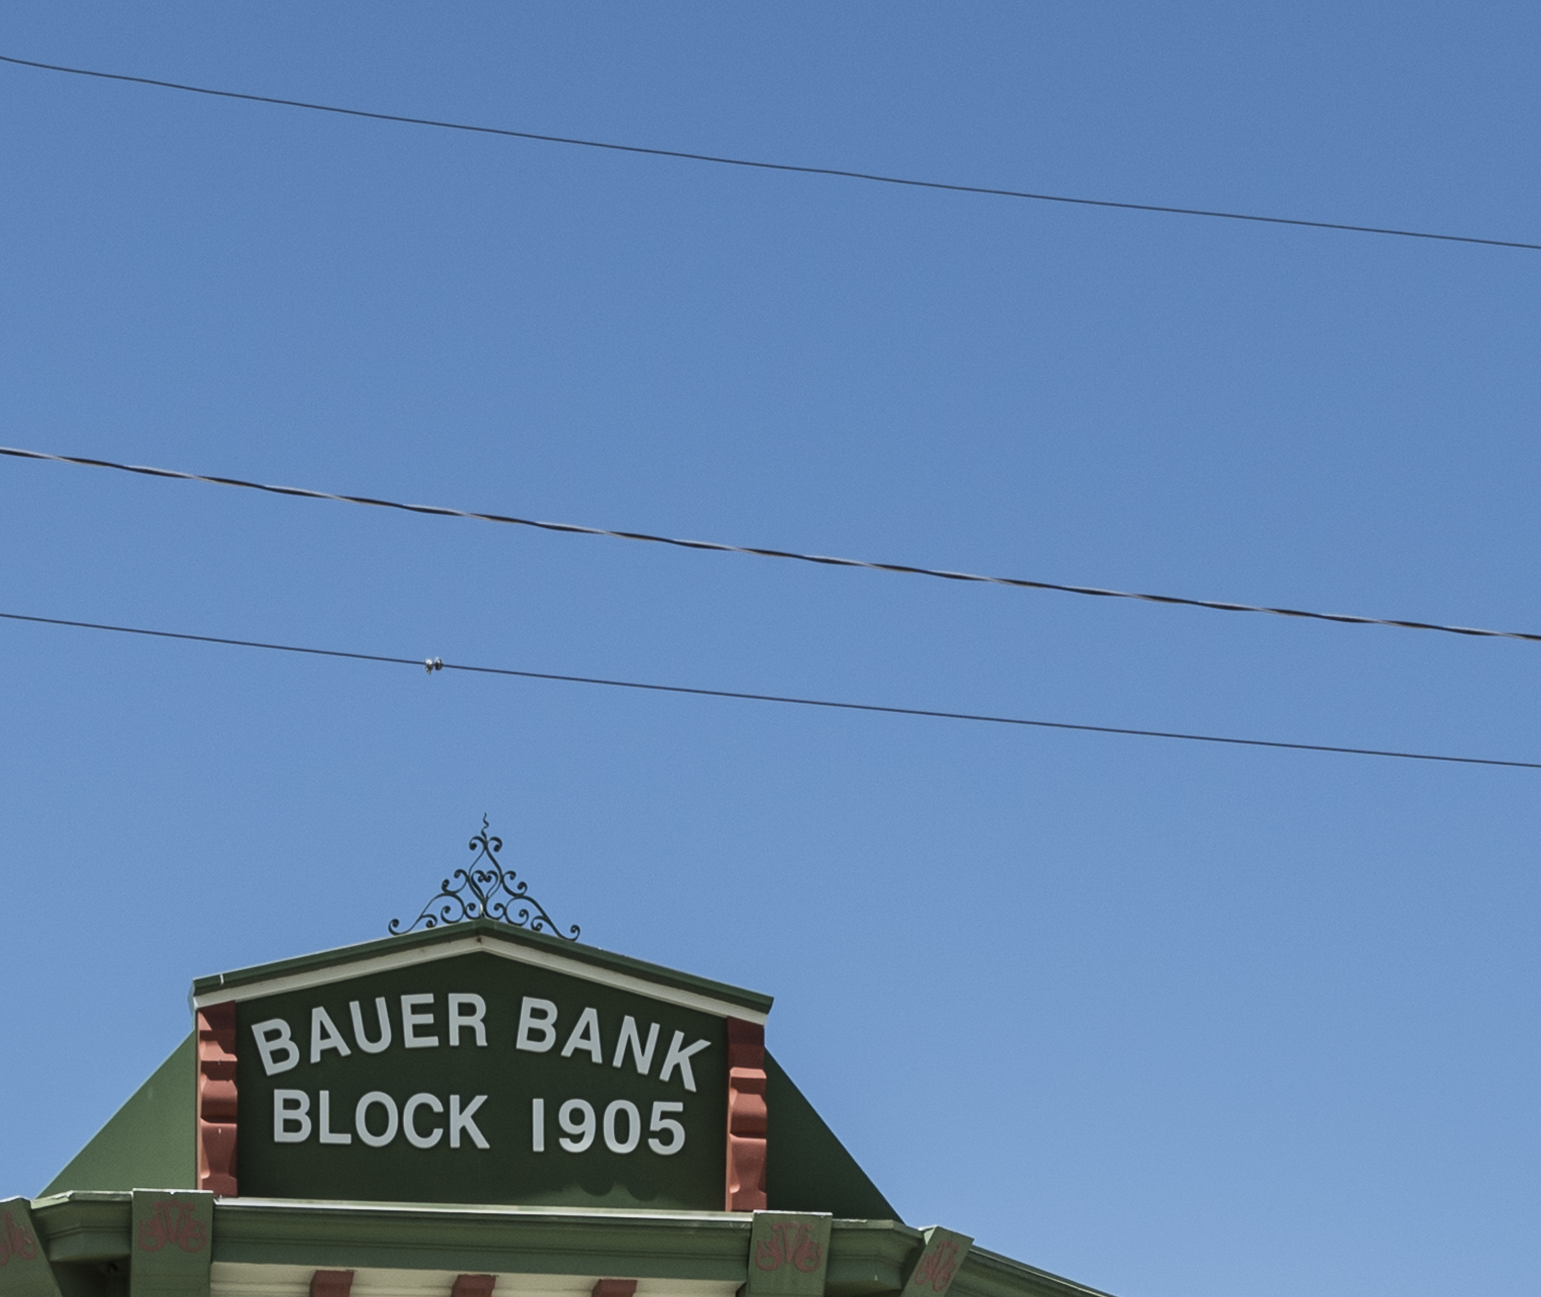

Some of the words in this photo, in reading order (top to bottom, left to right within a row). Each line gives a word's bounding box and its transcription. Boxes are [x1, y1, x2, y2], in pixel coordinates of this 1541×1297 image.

[251, 992, 488, 1076] BAUER
[516, 995, 711, 1092] BANK
[273, 1089, 490, 1150] BLOCK
[532, 1098, 686, 1156] 1905
